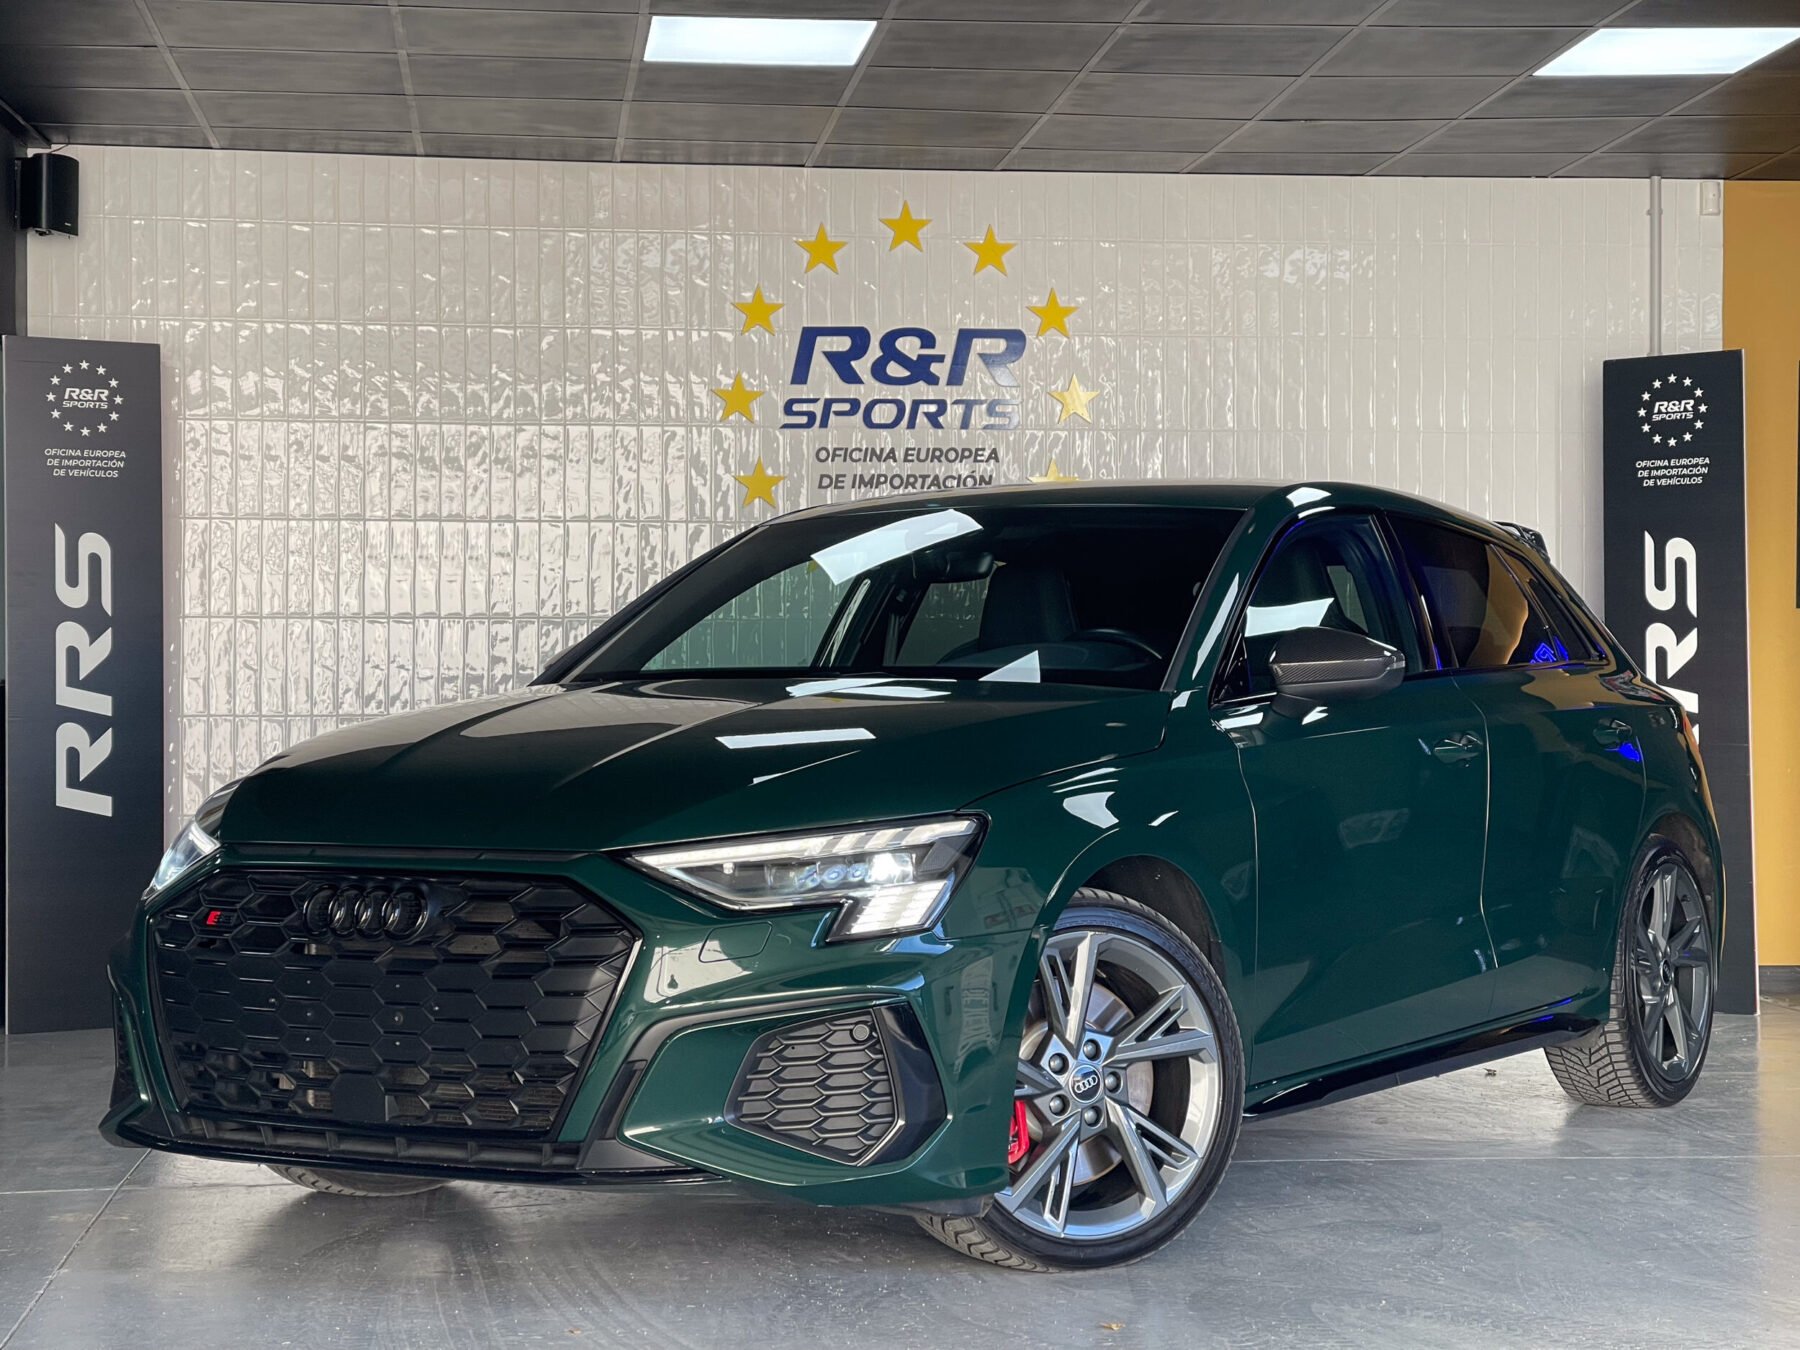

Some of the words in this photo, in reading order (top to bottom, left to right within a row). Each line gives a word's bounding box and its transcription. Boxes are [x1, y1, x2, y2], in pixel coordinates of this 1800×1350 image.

[790, 326, 1026, 388] R&R
[64, 387, 109, 401] R&R
[62, 400, 109, 409] SPORTS
[1653, 399, 1695, 413] R&R
[780, 397, 1023, 430] SPORTS
[1652, 412, 1694, 421] SPORTS
[44, 448, 82, 457] OFICINA
[83, 449, 126, 458] EUROPEA
[815, 446, 898, 464] OFICINA
[903, 446, 1000, 463] EUROPEA
[61, 458, 125, 468] IMPORTACIÓN
[1636, 460, 1669, 468] OFICINA
[1670, 457, 1710, 466] EUROPEA
[53, 468, 66, 476] DE
[68, 468, 119, 478] VEHÍCULOS
[1650, 466, 1708, 477] IMPORTACIÓN
[818, 473, 846, 490] DE
[851, 470, 993, 490] IMPORTACIÓN
[1643, 479, 1655, 487] DE
[1656, 477, 1703, 486] VEHÍCULOS
[1644, 530, 1699, 745] RS
[55, 523, 112, 817] RRS
